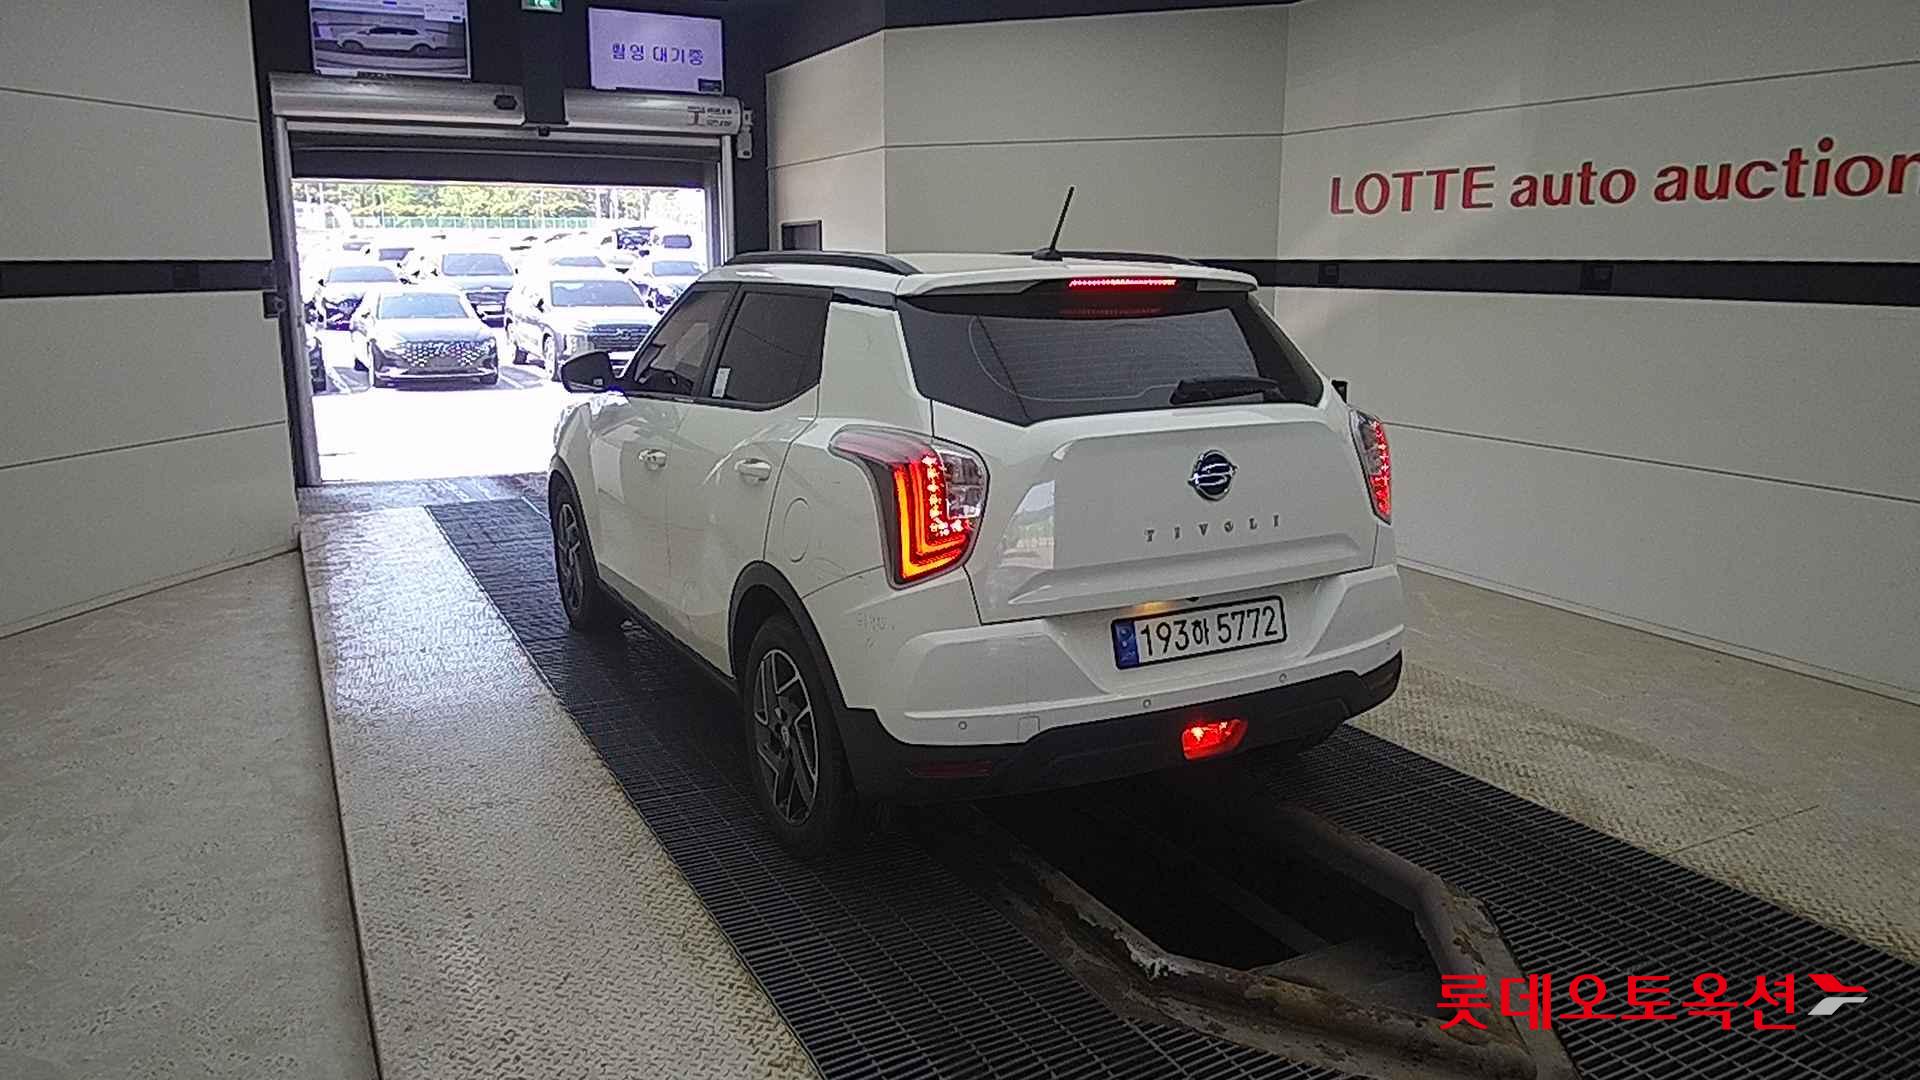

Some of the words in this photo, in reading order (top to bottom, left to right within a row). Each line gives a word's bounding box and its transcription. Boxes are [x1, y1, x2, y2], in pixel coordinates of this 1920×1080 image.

[652, 47, 705, 66] 대기중
[1331, 165, 1496, 215] LOTTE
[1510, 161, 1638, 208] auto
[1145, 514, 1281, 543] TIVOLI
